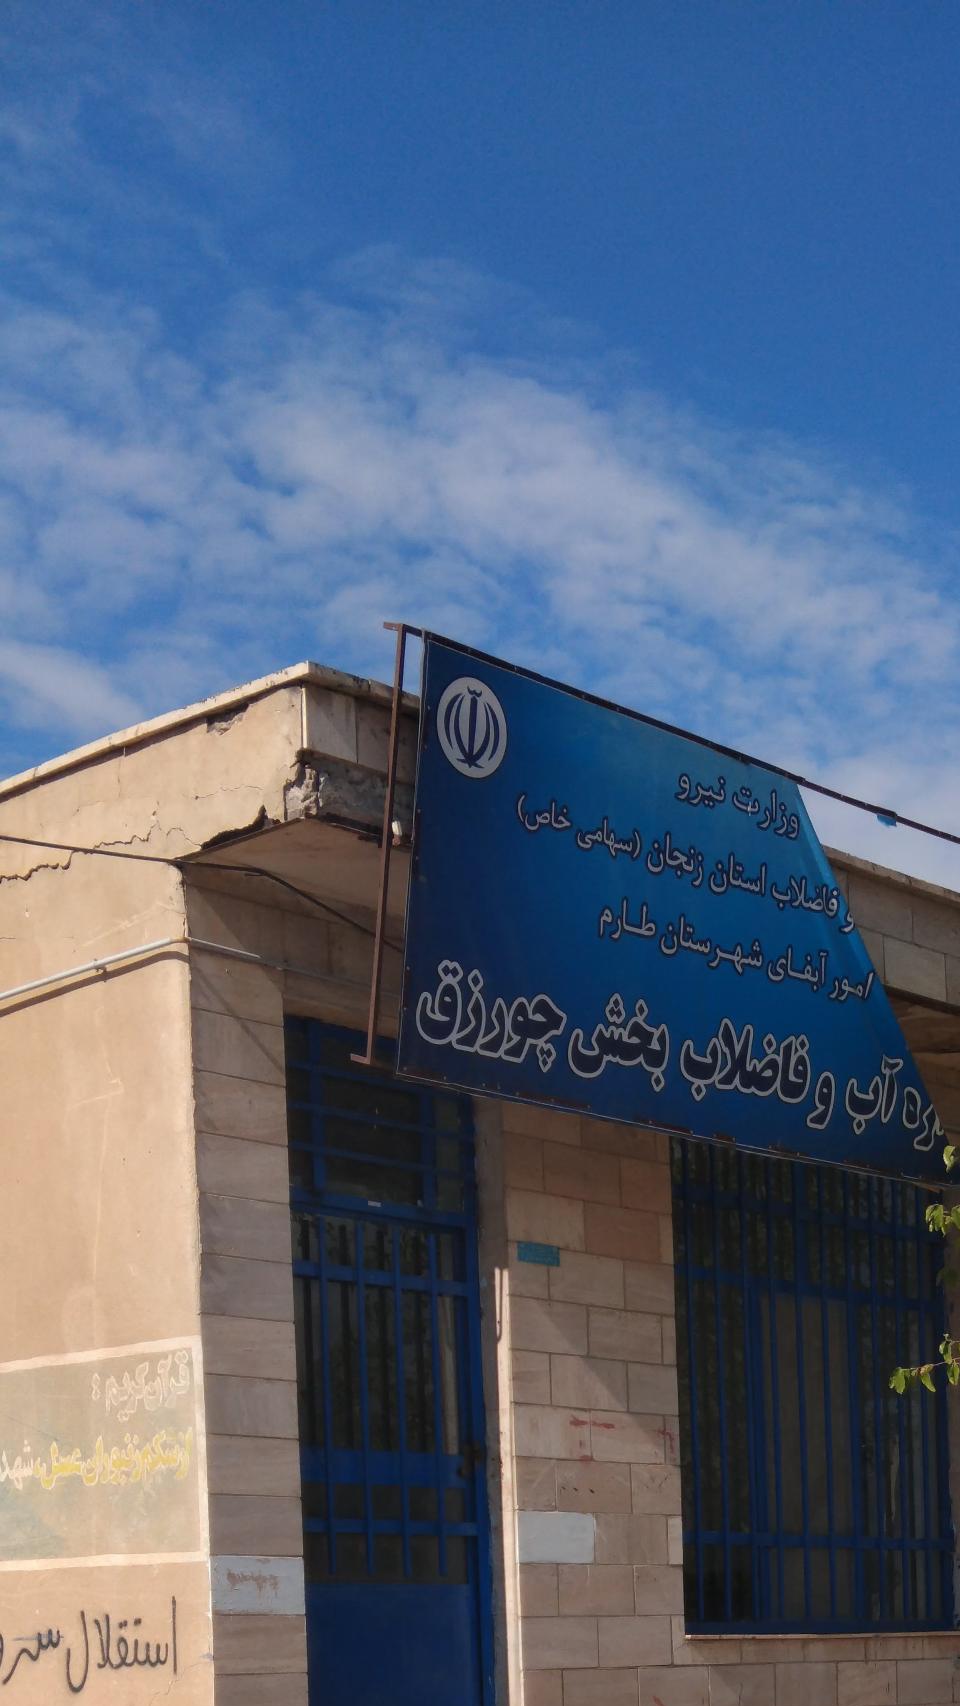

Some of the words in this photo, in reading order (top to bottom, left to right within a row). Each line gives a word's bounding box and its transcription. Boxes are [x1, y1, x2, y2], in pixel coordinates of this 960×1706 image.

[676, 774, 725, 807] نیرو
[732, 786, 800, 838] وزارت
[647, 833, 704, 886] زنجان
[710, 854, 766, 895] استان
[600, 899, 656, 939] طارم
[772, 877, 839, 917] فاضلاب
[660, 915, 763, 975] شهرستان
[768, 947, 827, 992] آبفای
[829, 971, 876, 1001] امور
[415, 959, 568, 1073] چورزق
[567, 992, 670, 1092] بخش
[680, 1018, 811, 1104] فاضلاب
[806, 1070, 836, 1130] و
[845, 1053, 904, 1135] آب
[903, 1087, 945, 1151] ره
[67, 1595, 177, 1693] استقلال
